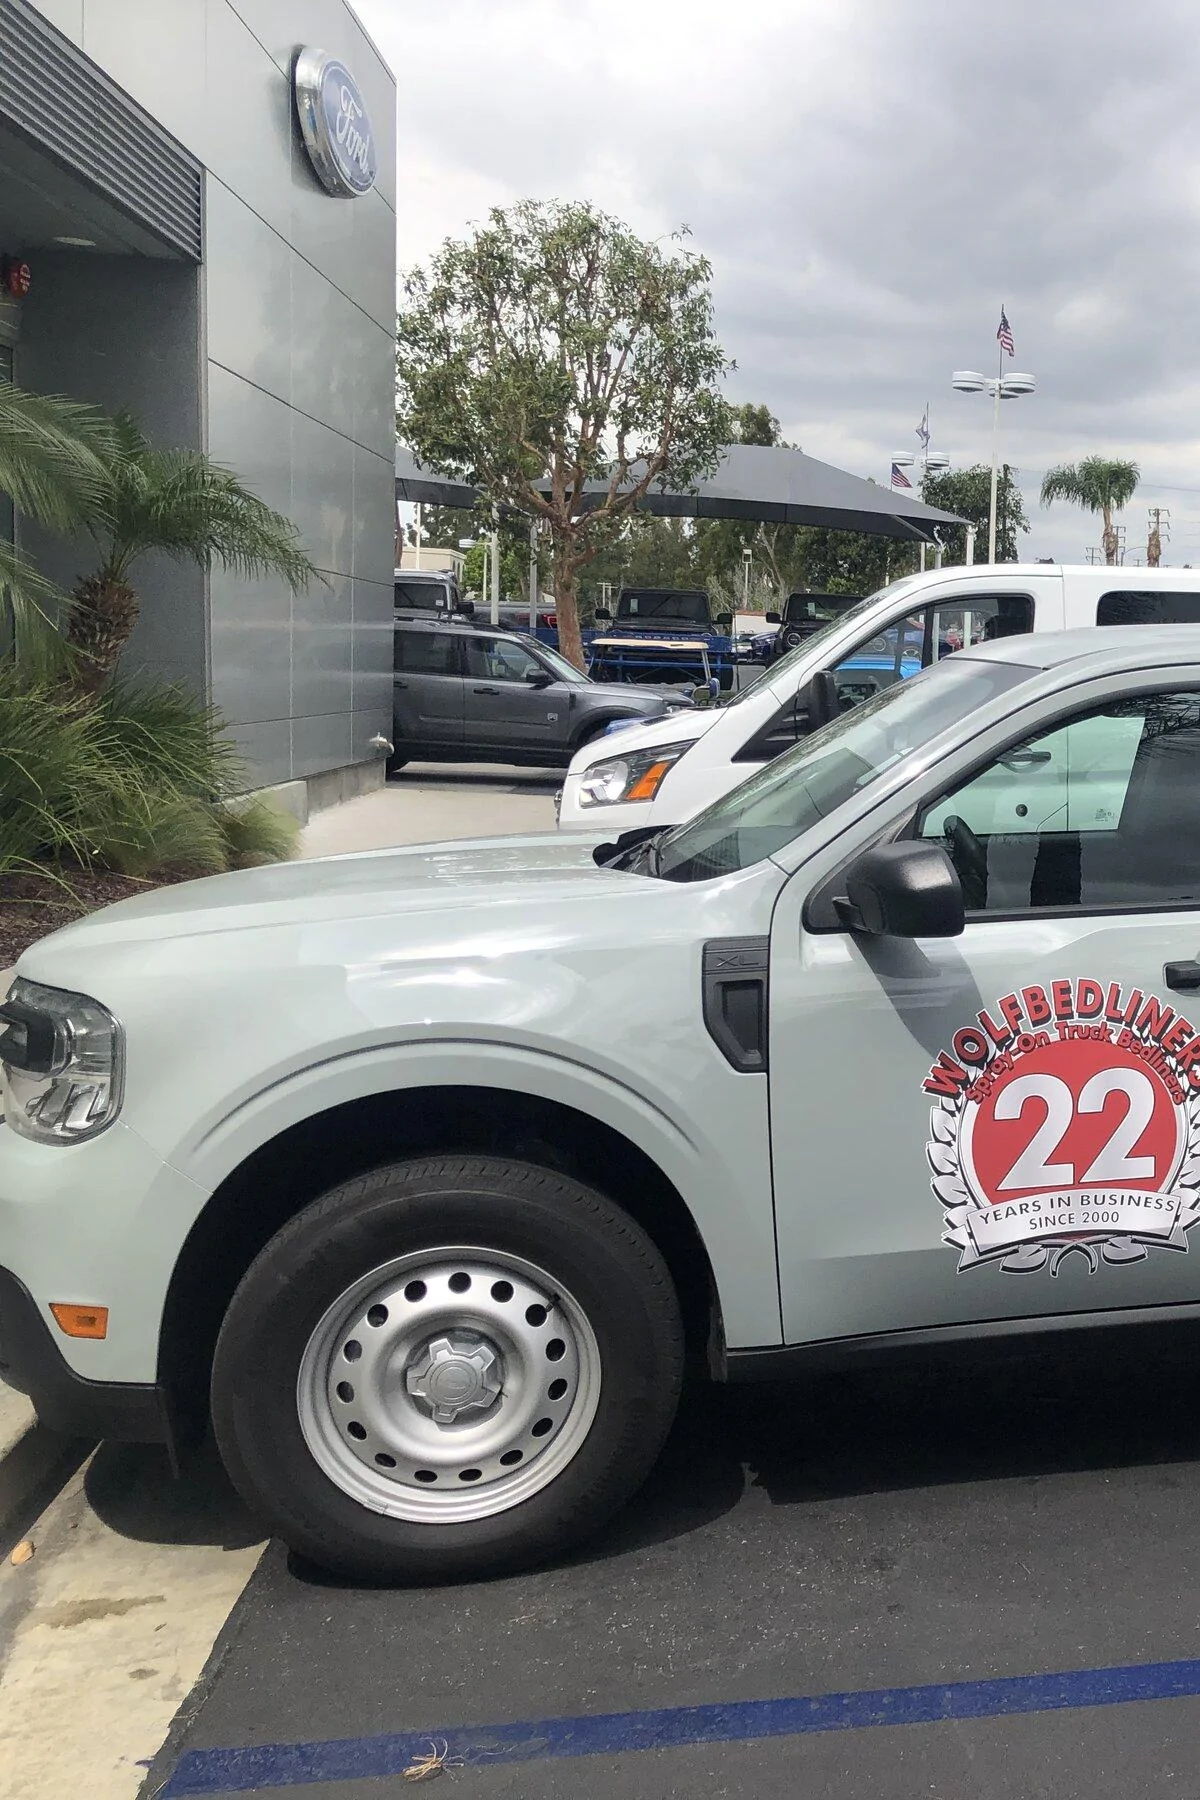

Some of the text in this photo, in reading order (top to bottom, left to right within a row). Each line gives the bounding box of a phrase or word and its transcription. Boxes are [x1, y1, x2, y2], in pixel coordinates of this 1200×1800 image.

[335, 85, 369, 174] Ford
[966, 1021, 1187, 1105] Spray-On Truck Bedliners
[993, 1067, 1156, 1191] 22
[979, 1193, 1176, 1225] YEARS IN BUSINESS
[1029, 1211, 1120, 1230] SINCE 2000
